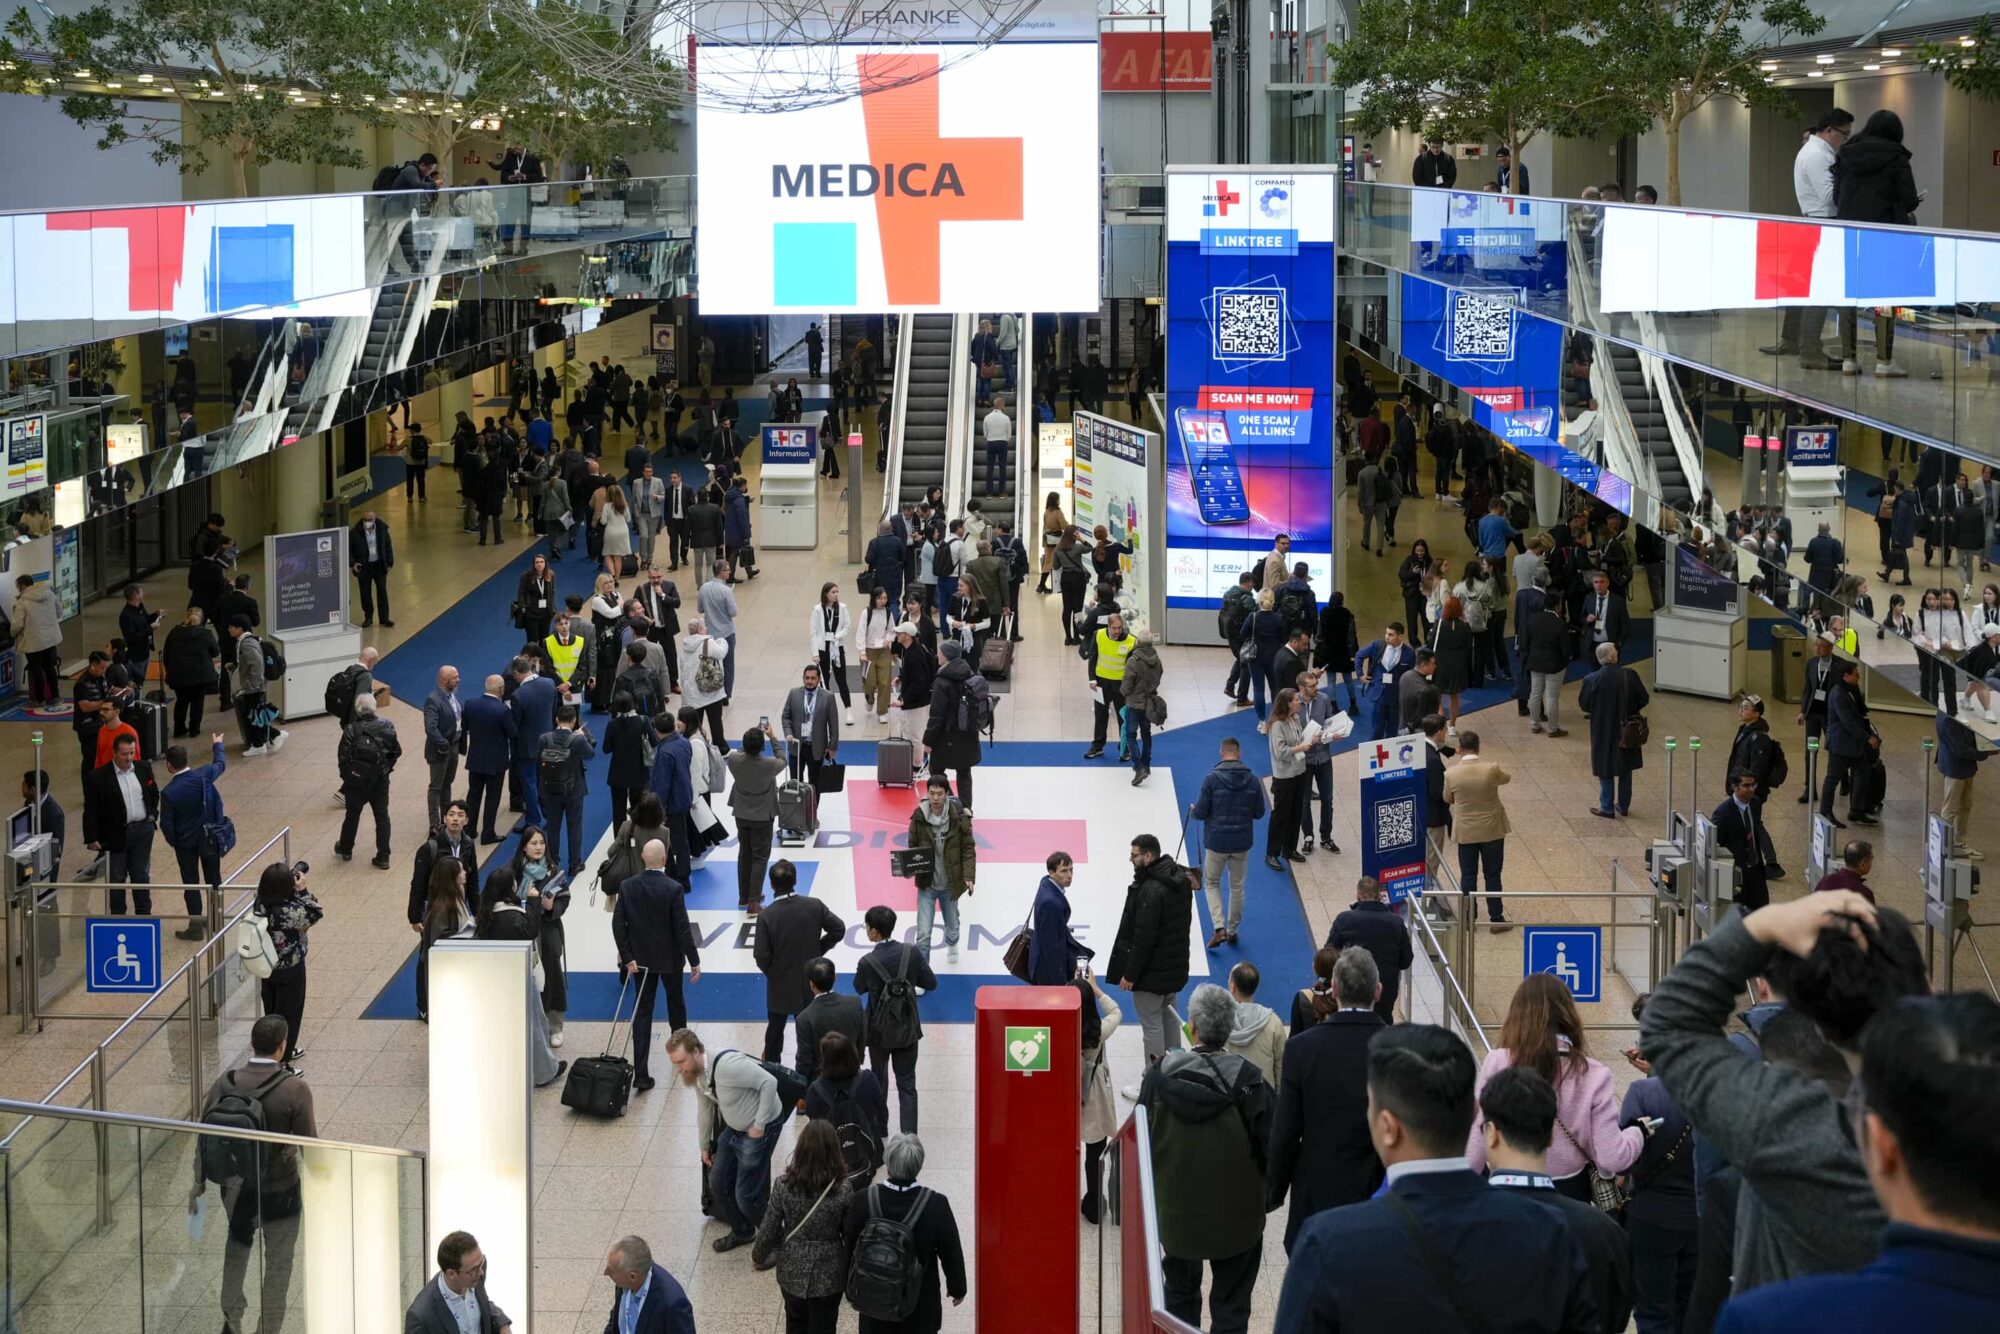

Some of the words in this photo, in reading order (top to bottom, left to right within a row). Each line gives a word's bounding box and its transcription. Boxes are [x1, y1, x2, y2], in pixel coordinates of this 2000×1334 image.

[861, 9, 960, 24] FRANKE
[772, 163, 965, 198] MEDICA
[1215, 235, 1283, 247] LINKTREE
[1211, 393, 1242, 403] SCAN
[1245, 394, 1263, 404] ME
[1266, 395, 1299, 405] NOW!
[1239, 415, 1260, 425] ONE
[1262, 416, 1290, 425] SCAN
[1241, 426, 1261, 436] ALL
[1264, 427, 1296, 436] LINKS
[1680, 566, 1703, 575] Where
[1680, 575, 1718, 586] healthcare
[281, 582, 311, 592] High-tech
[1687, 585, 1708, 594] going
[281, 590, 309, 599] solutions
[291, 595, 315, 604] medical
[281, 604, 315, 613] technology
[1384, 870, 1398, 879] SCAN
[1406, 879, 1420, 887] SCAN
[1395, 889, 1406, 897] ALL
